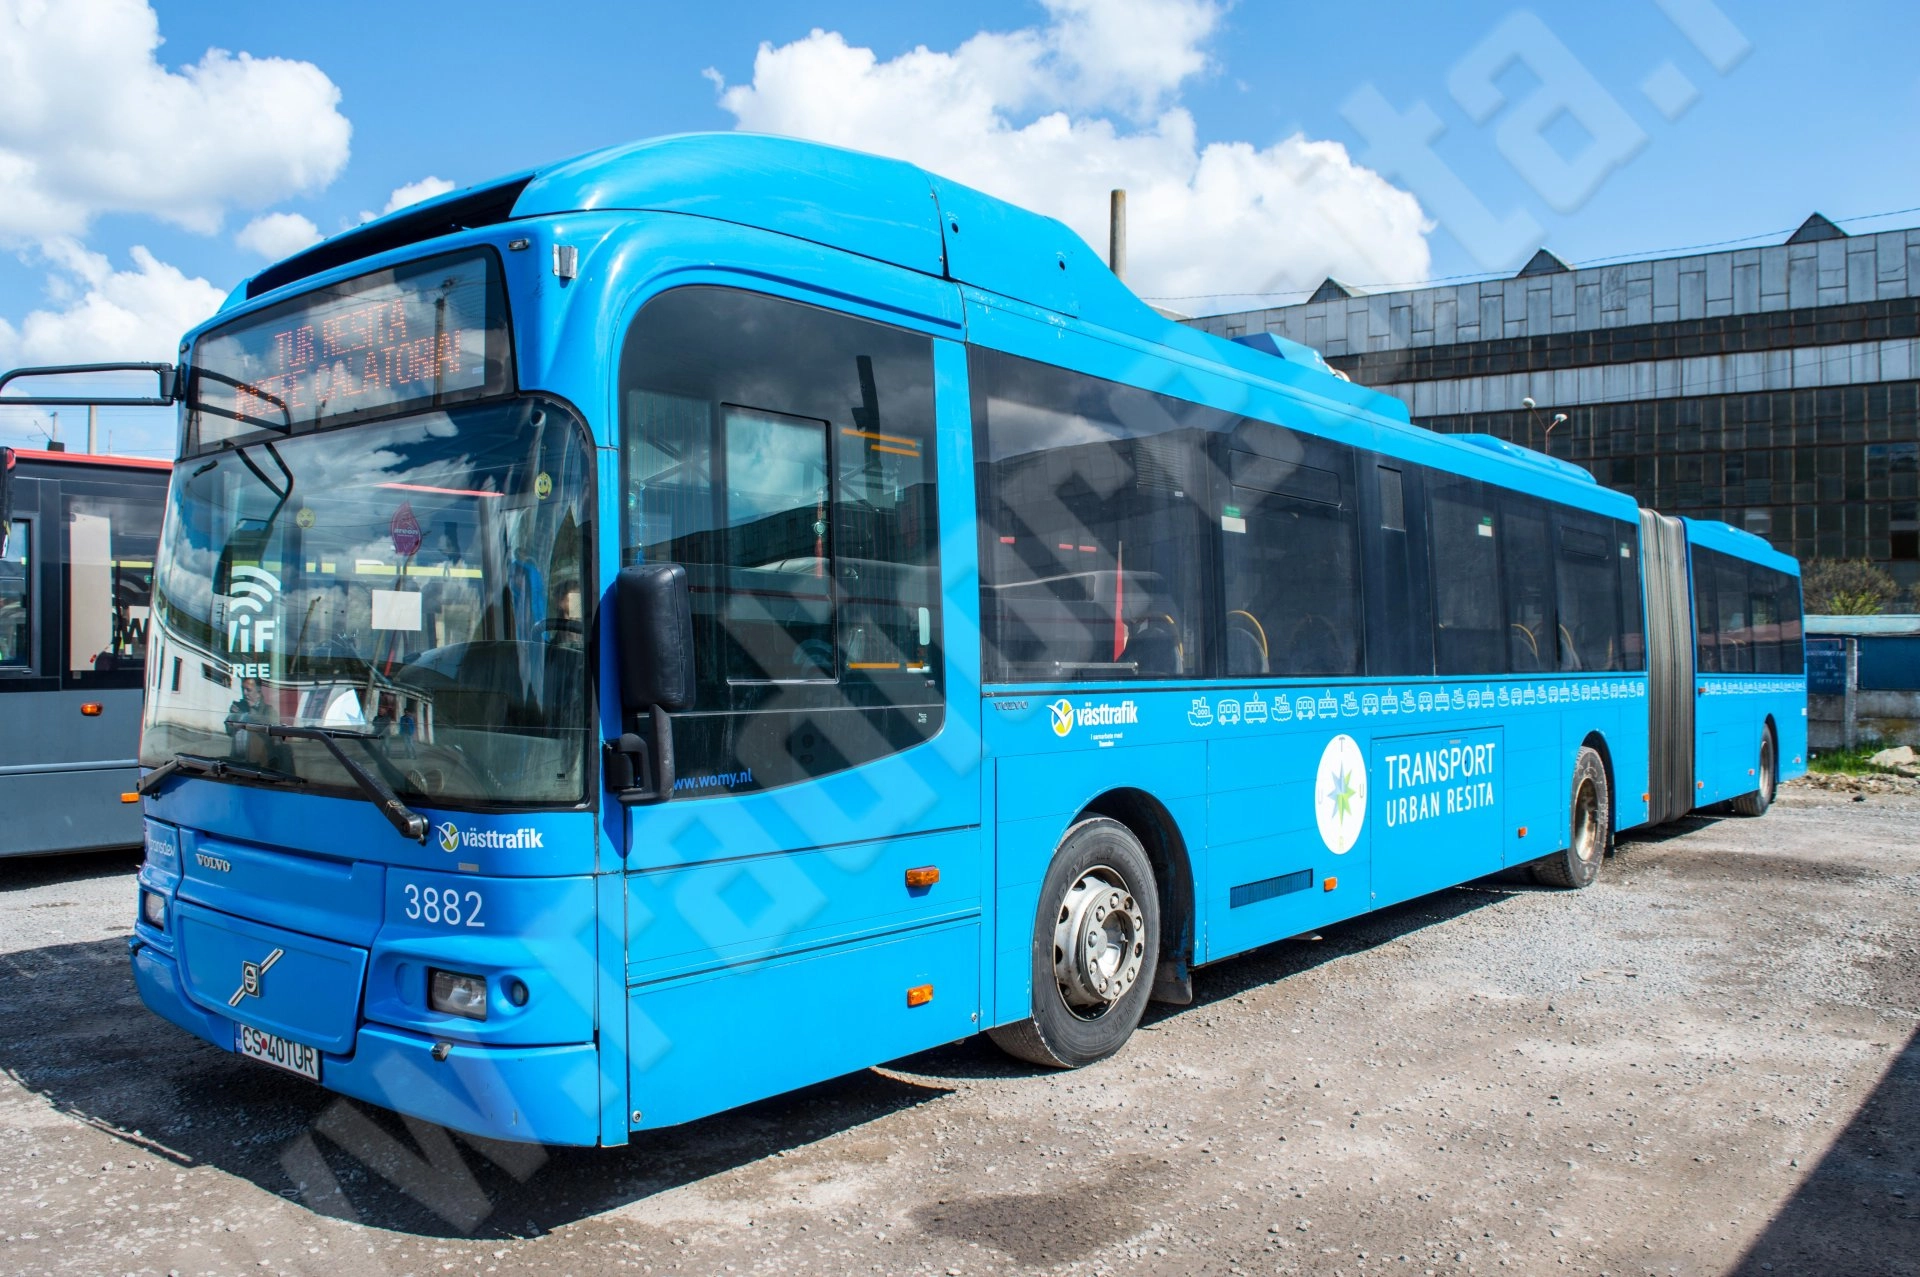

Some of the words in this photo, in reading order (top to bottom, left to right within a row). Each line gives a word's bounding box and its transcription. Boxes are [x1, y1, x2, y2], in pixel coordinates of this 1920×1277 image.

[274, 324, 314, 370] TUR
[322, 299, 407, 358] RESITA
[1076, 700, 1139, 726] västtrafik
[1385, 743, 1495, 790] TRANSPORT
[1386, 791, 1440, 827] URBAN
[1447, 782, 1494, 814] RESITA
[462, 828, 544, 849] västtrafik
[195, 853, 231, 873] VOLVO
[404, 883, 485, 928] 3882
